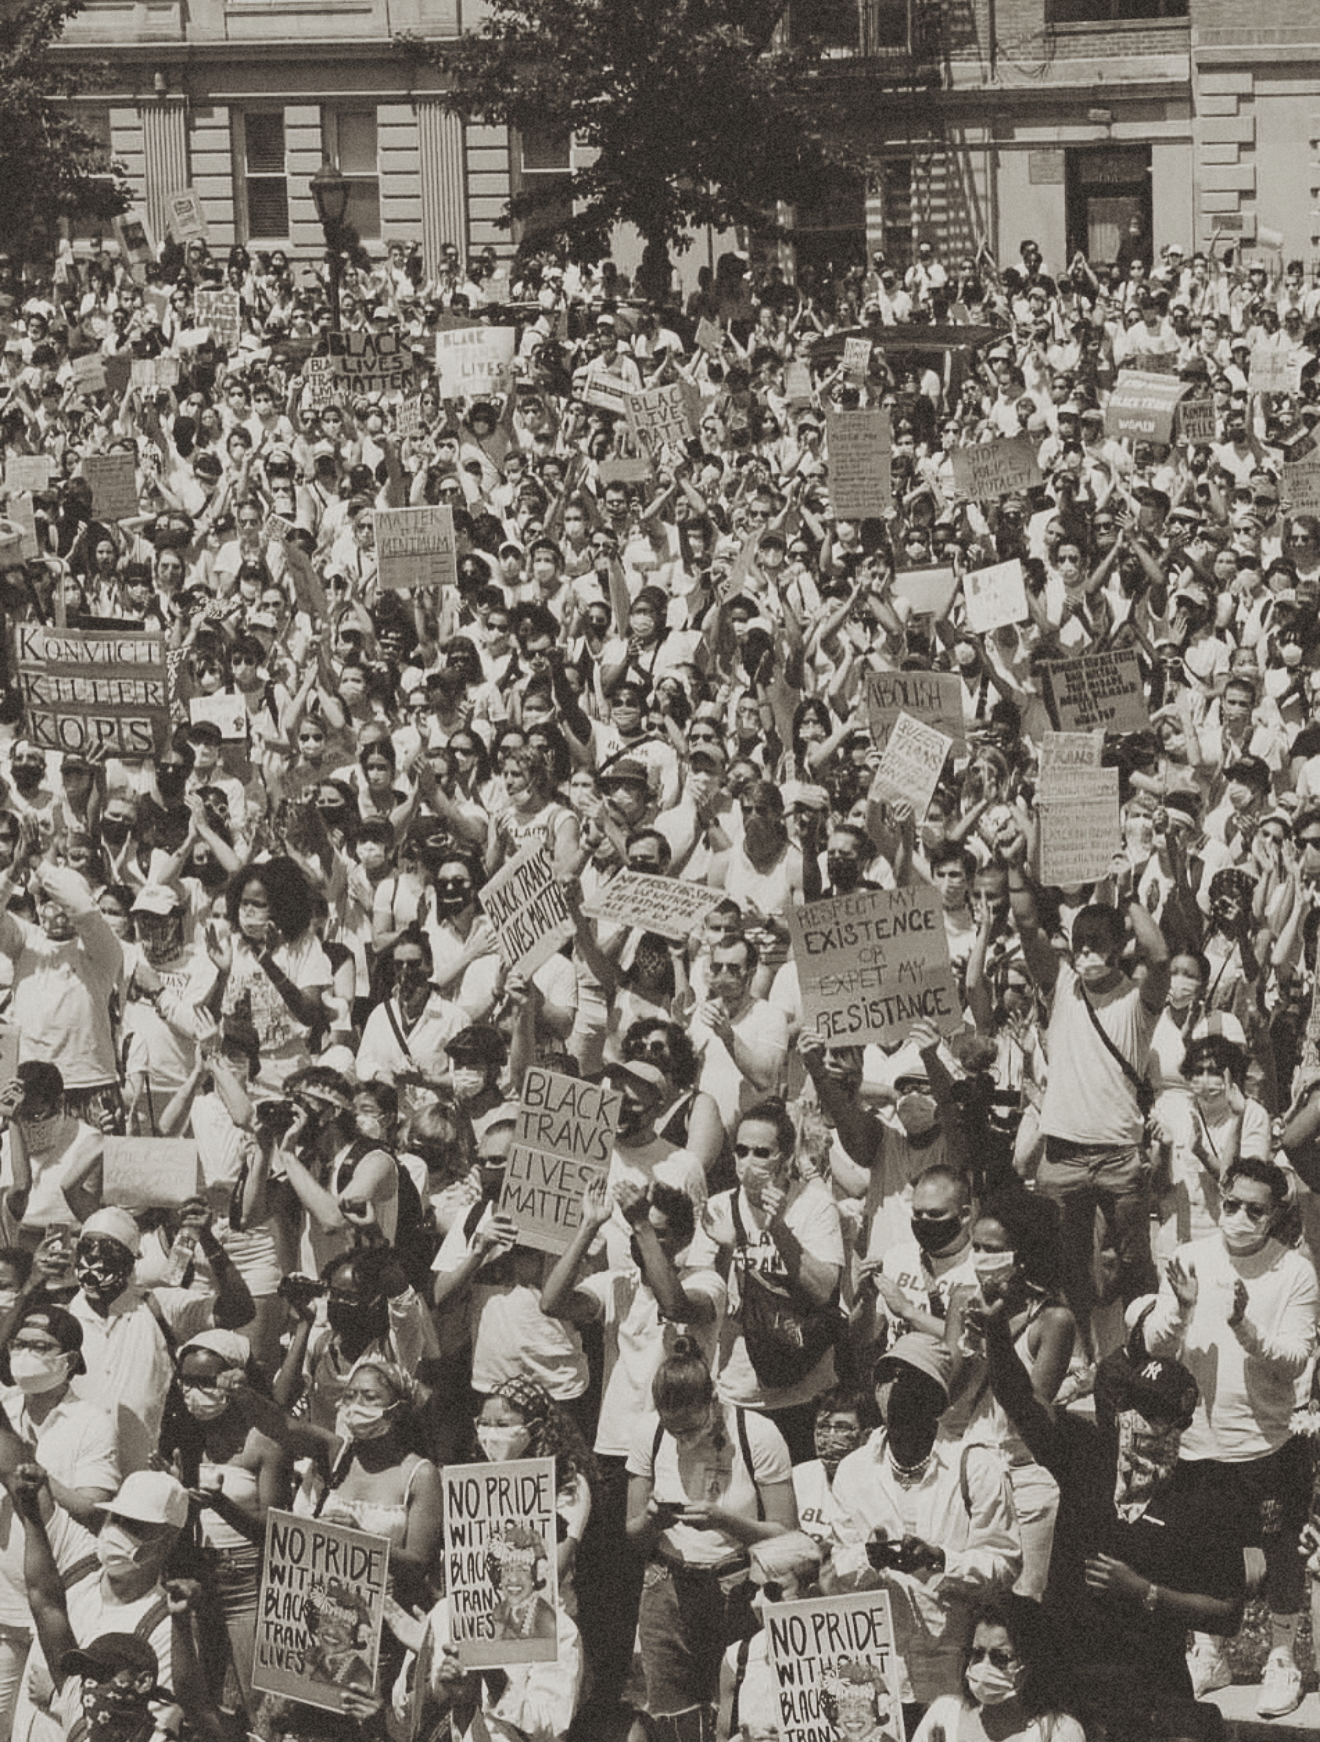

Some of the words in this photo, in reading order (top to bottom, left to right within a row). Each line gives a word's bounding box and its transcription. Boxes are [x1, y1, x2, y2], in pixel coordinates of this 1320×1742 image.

[329, 331, 412, 357] BLACK
[443, 330, 484, 347] BLACK
[333, 369, 414, 395] MATTER
[341, 356, 404, 374] LIVES
[461, 361, 504, 376] LIVES
[631, 386, 679, 412] BLAC
[635, 403, 682, 430] LIVE
[966, 444, 999, 464] STOP
[972, 457, 1024, 478] POLICE
[969, 461, 1032, 498] BRUTALITY
[20, 627, 160, 663] KONVICT
[22, 672, 165, 706] KILLER
[867, 679, 942, 711] ABOLISH
[31, 711, 153, 751] KOPS
[898, 718, 945, 754] QUEER
[893, 732, 944, 771] TRANS
[485, 880, 523, 932] BLACK
[514, 848, 553, 900] TRANS
[501, 911, 535, 965] LIVES
[526, 880, 569, 940] MATTER
[796, 892, 877, 929] RESPECT
[889, 886, 916, 910] MY
[858, 943, 887, 964] OR
[898, 957, 926, 984] MY
[524, 1071, 618, 1127] BLACK
[521, 1110, 613, 1161] TRANS
[509, 1149, 595, 1195] LIVES
[448, 1477, 480, 1520] NO
[485, 1473, 552, 1517] PRIDE
[271, 1522, 306, 1565] NO
[311, 1533, 383, 1588] PRIDE
[452, 1613, 495, 1641] LIVES
[769, 1615, 808, 1658] NO
[811, 1608, 890, 1655] PRIDE
[260, 1644, 305, 1676] LIVES
